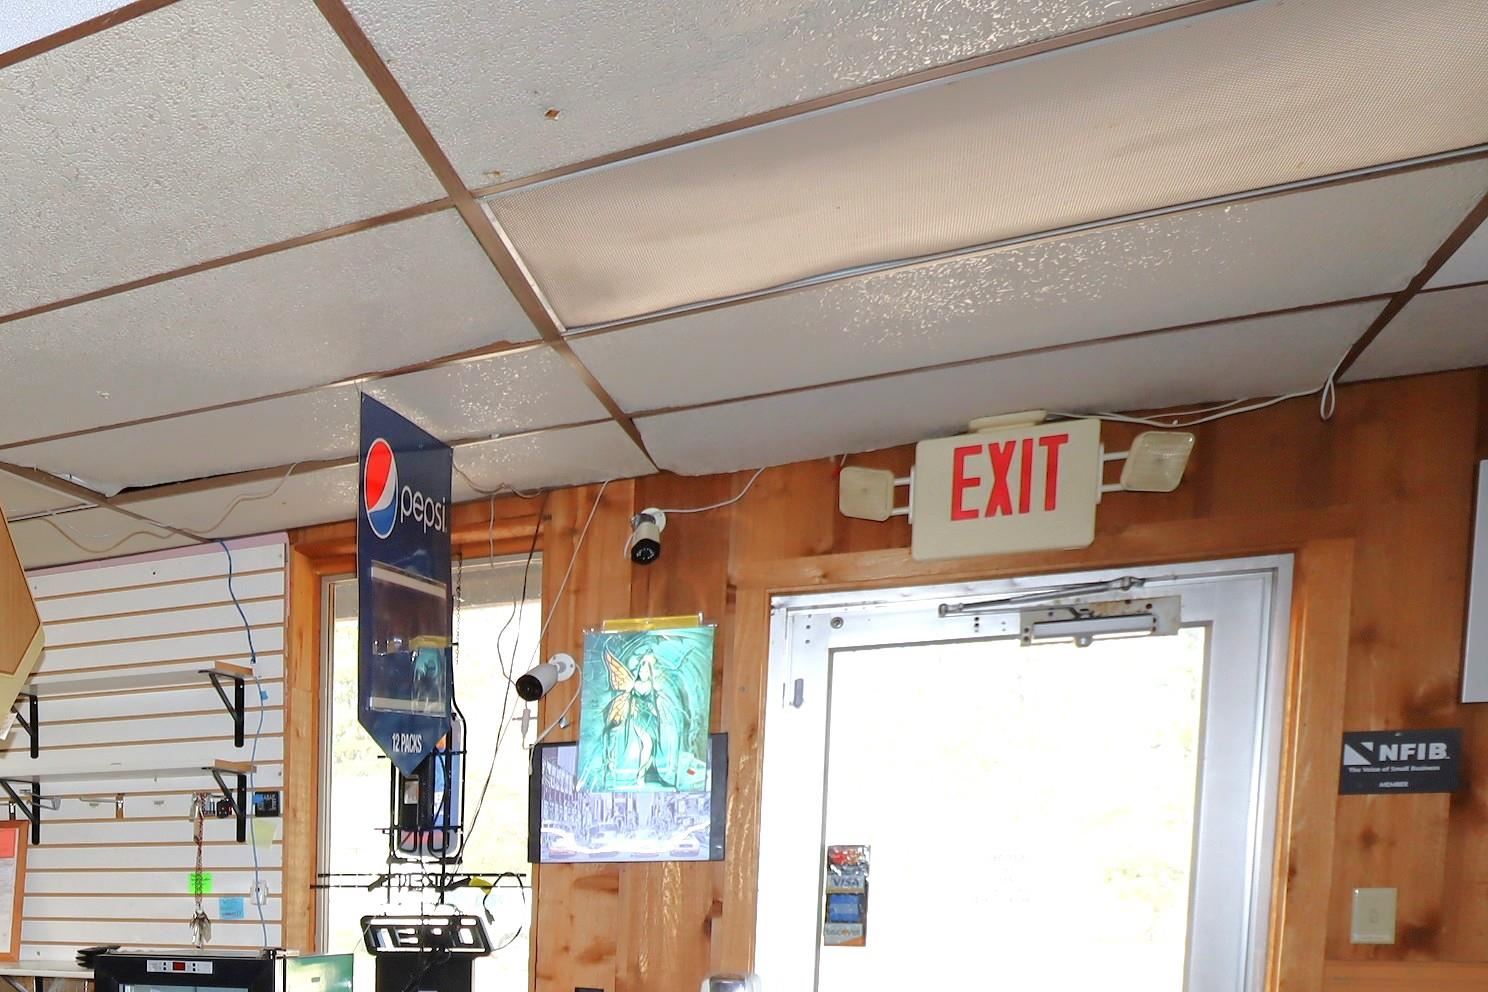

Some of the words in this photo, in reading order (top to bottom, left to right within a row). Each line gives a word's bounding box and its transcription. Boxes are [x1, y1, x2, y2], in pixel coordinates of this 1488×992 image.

[951, 433, 1069, 521] EXIT
[400, 484, 446, 535] pepsi
[391, 733, 400, 751] 12
[401, 734, 422, 754] PACKS
[1379, 742, 1448, 761] NFIB
[833, 879, 859, 887] VISA
